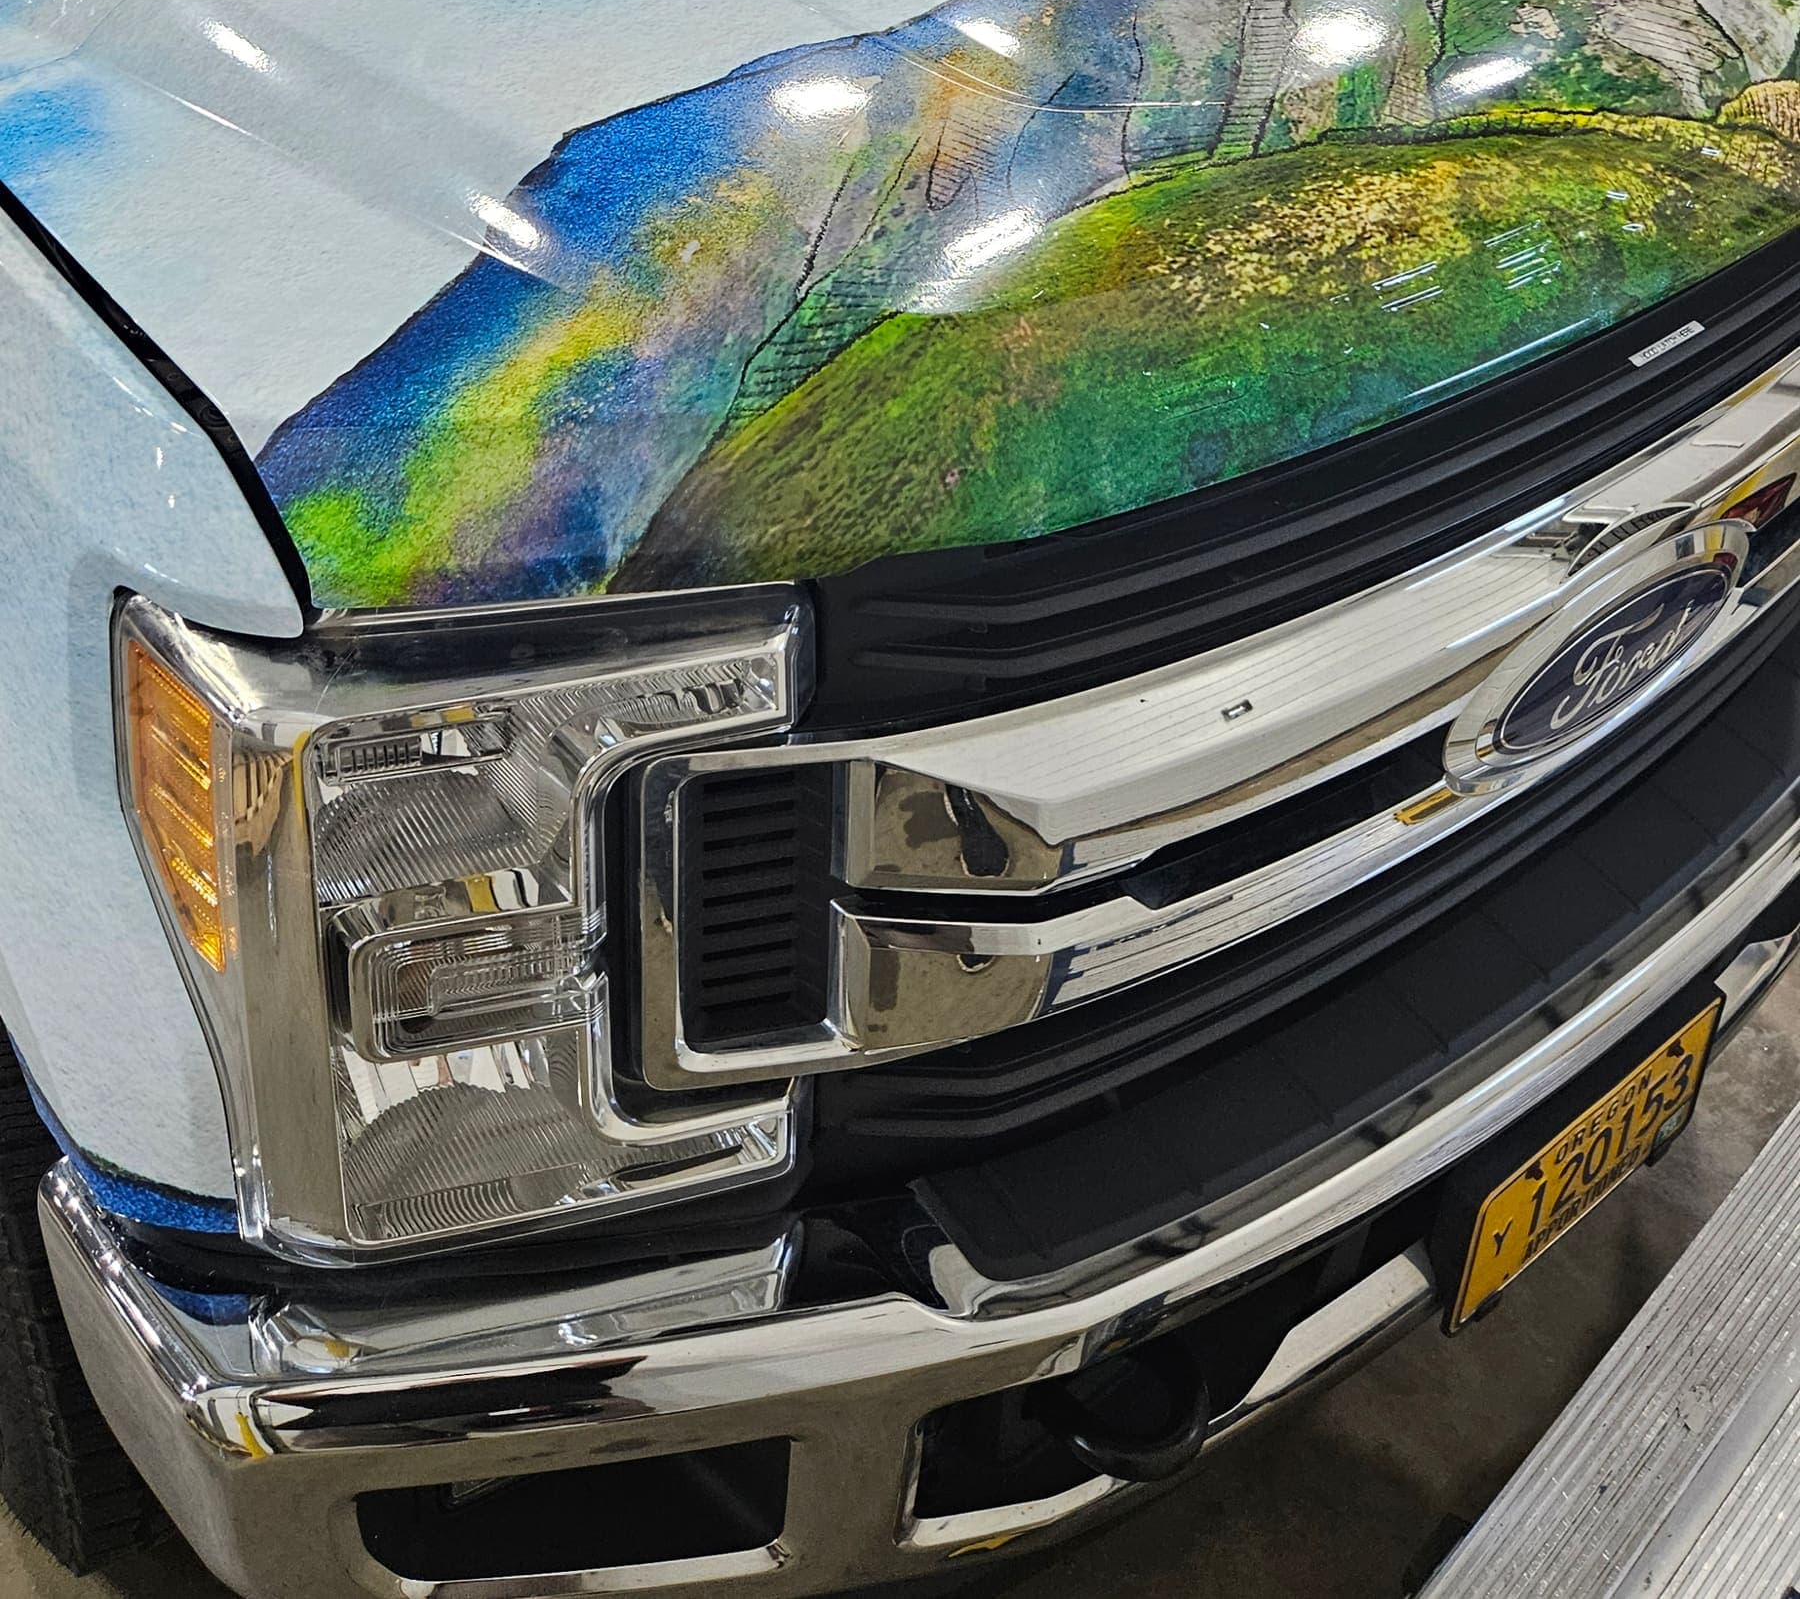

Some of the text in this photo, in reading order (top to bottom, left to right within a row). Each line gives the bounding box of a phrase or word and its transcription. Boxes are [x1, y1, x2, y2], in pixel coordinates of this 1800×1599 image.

[1550, 600, 1695, 730] Ford
[1492, 1054, 1694, 1257] Y 120153
[1554, 1069, 1653, 1164] OREGON
[1521, 1144, 1642, 1264] APPORTIONED
